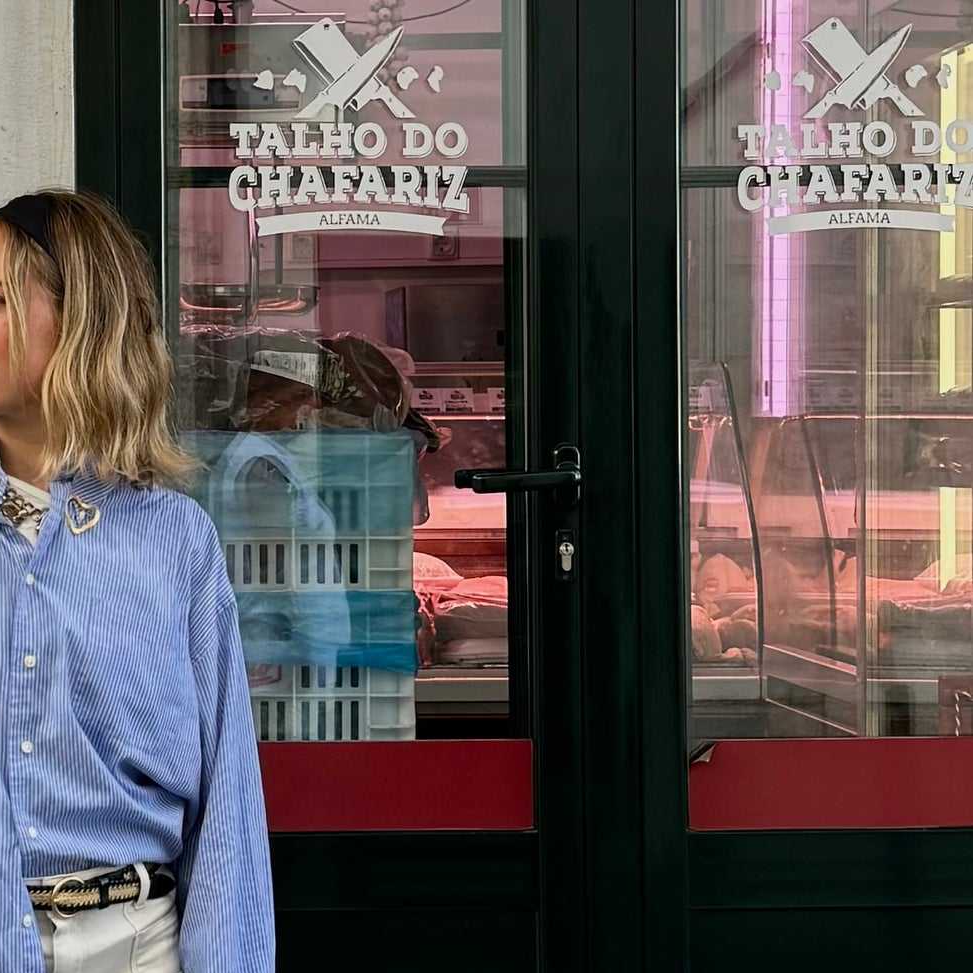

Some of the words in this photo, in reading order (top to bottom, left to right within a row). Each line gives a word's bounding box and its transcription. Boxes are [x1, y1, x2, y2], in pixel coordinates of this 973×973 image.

[229, 122, 388, 159] TALHO
[402, 122, 469, 159] DO
[737, 121, 897, 161] TALHO
[911, 120, 973, 157] DO
[228, 165, 470, 214] CHAFARIZ
[737, 163, 973, 212] CHAFARIZ
[319, 214, 381, 226] ALFAMA
[828, 212, 891, 225] ALFAMA
